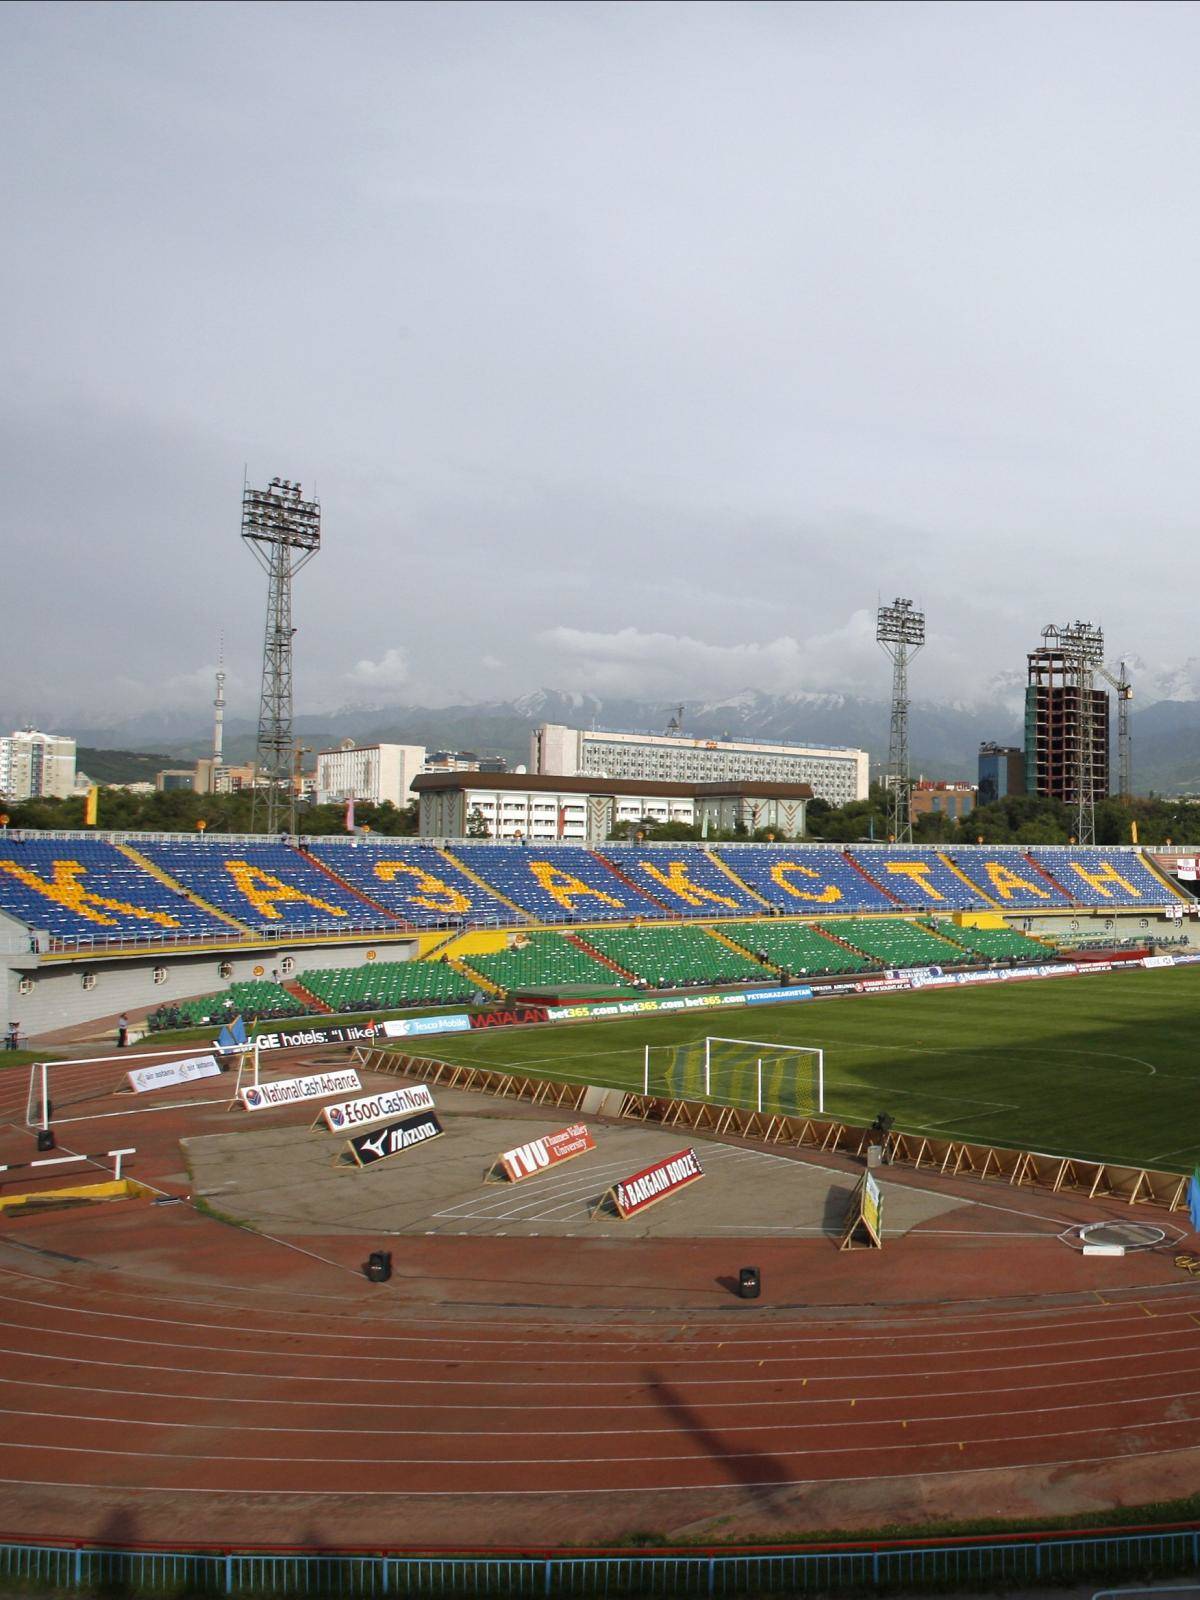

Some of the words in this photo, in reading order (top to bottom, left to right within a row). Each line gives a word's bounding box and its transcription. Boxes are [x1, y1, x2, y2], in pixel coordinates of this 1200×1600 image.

[414, 1021, 438, 1031] Tesco
[439, 1018, 467, 1029] Mobile
[469, 1008, 548, 1028] MATALAN
[544, 1132, 569, 1147] Thames
[567, 1124, 588, 1138] Valley
[553, 1138, 588, 1157] University
[503, 1139, 551, 1178] TVU
[626, 1166, 670, 1206] BARGAIN
[667, 1153, 698, 1185] BOOZE
